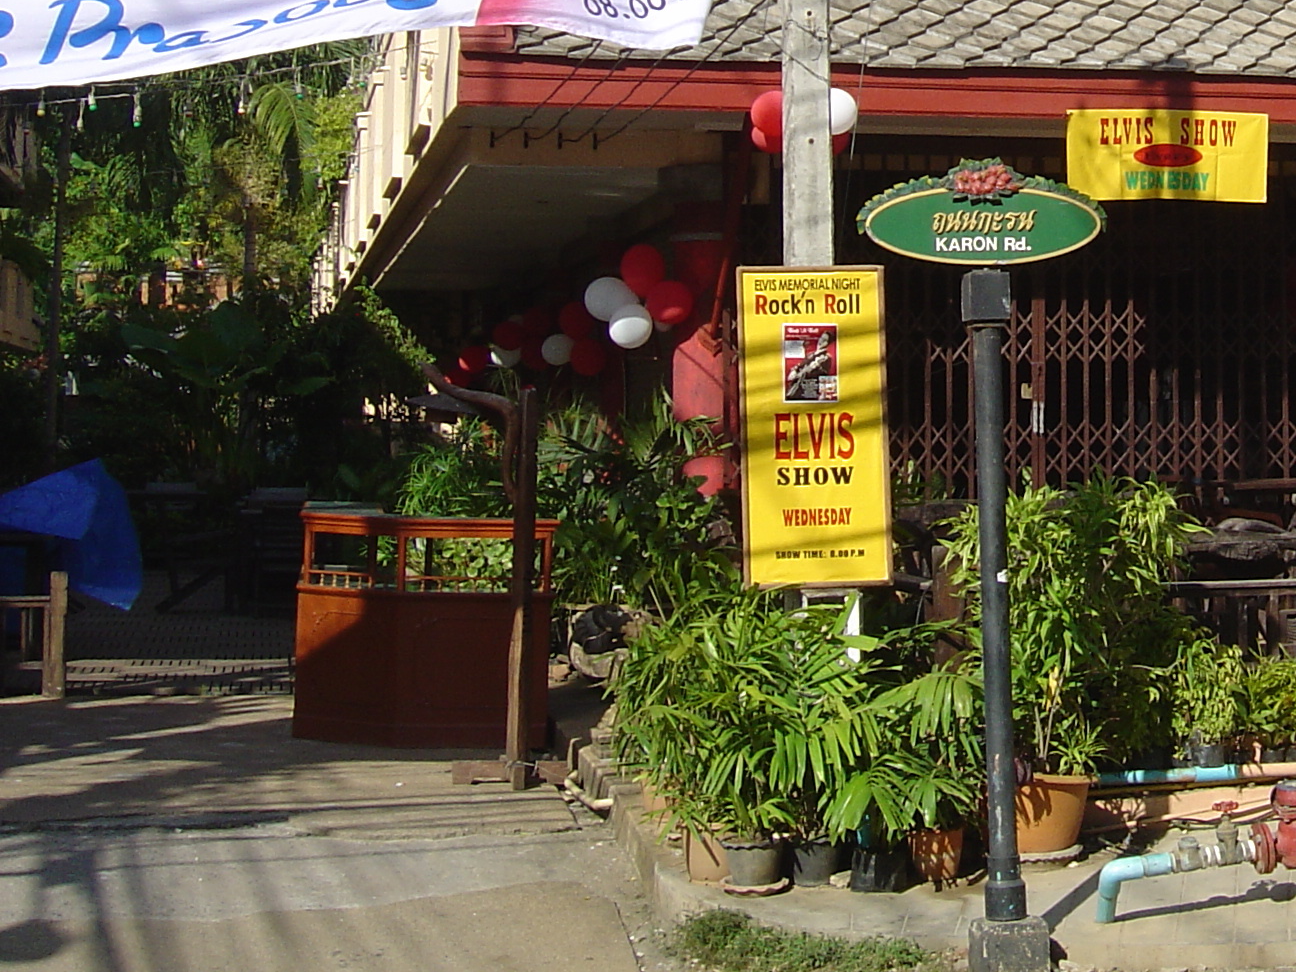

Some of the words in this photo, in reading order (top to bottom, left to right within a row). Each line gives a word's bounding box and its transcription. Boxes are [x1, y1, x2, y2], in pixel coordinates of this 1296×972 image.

[1100, 117, 1155, 146] ELVIS
[1180, 118, 1237, 148] SHOW
[1124, 170, 1210, 192] WEDNESDAY
[931, 208, 1037, 234] ถนนกะรน
[935, 236, 998, 252] KARON
[1003, 236, 1032, 251] Rd.
[754, 278, 777, 291] ELVIS
[778, 277, 830, 291] MEMORIAL
[831, 277, 861, 290] NIGHT
[824, 292, 861, 314] Roll
[774, 412, 855, 461] ELVIS
[776, 466, 854, 486] SHOW
[782, 507, 852, 527] WEDNESDAY
[775, 550, 801, 559] SHOW
